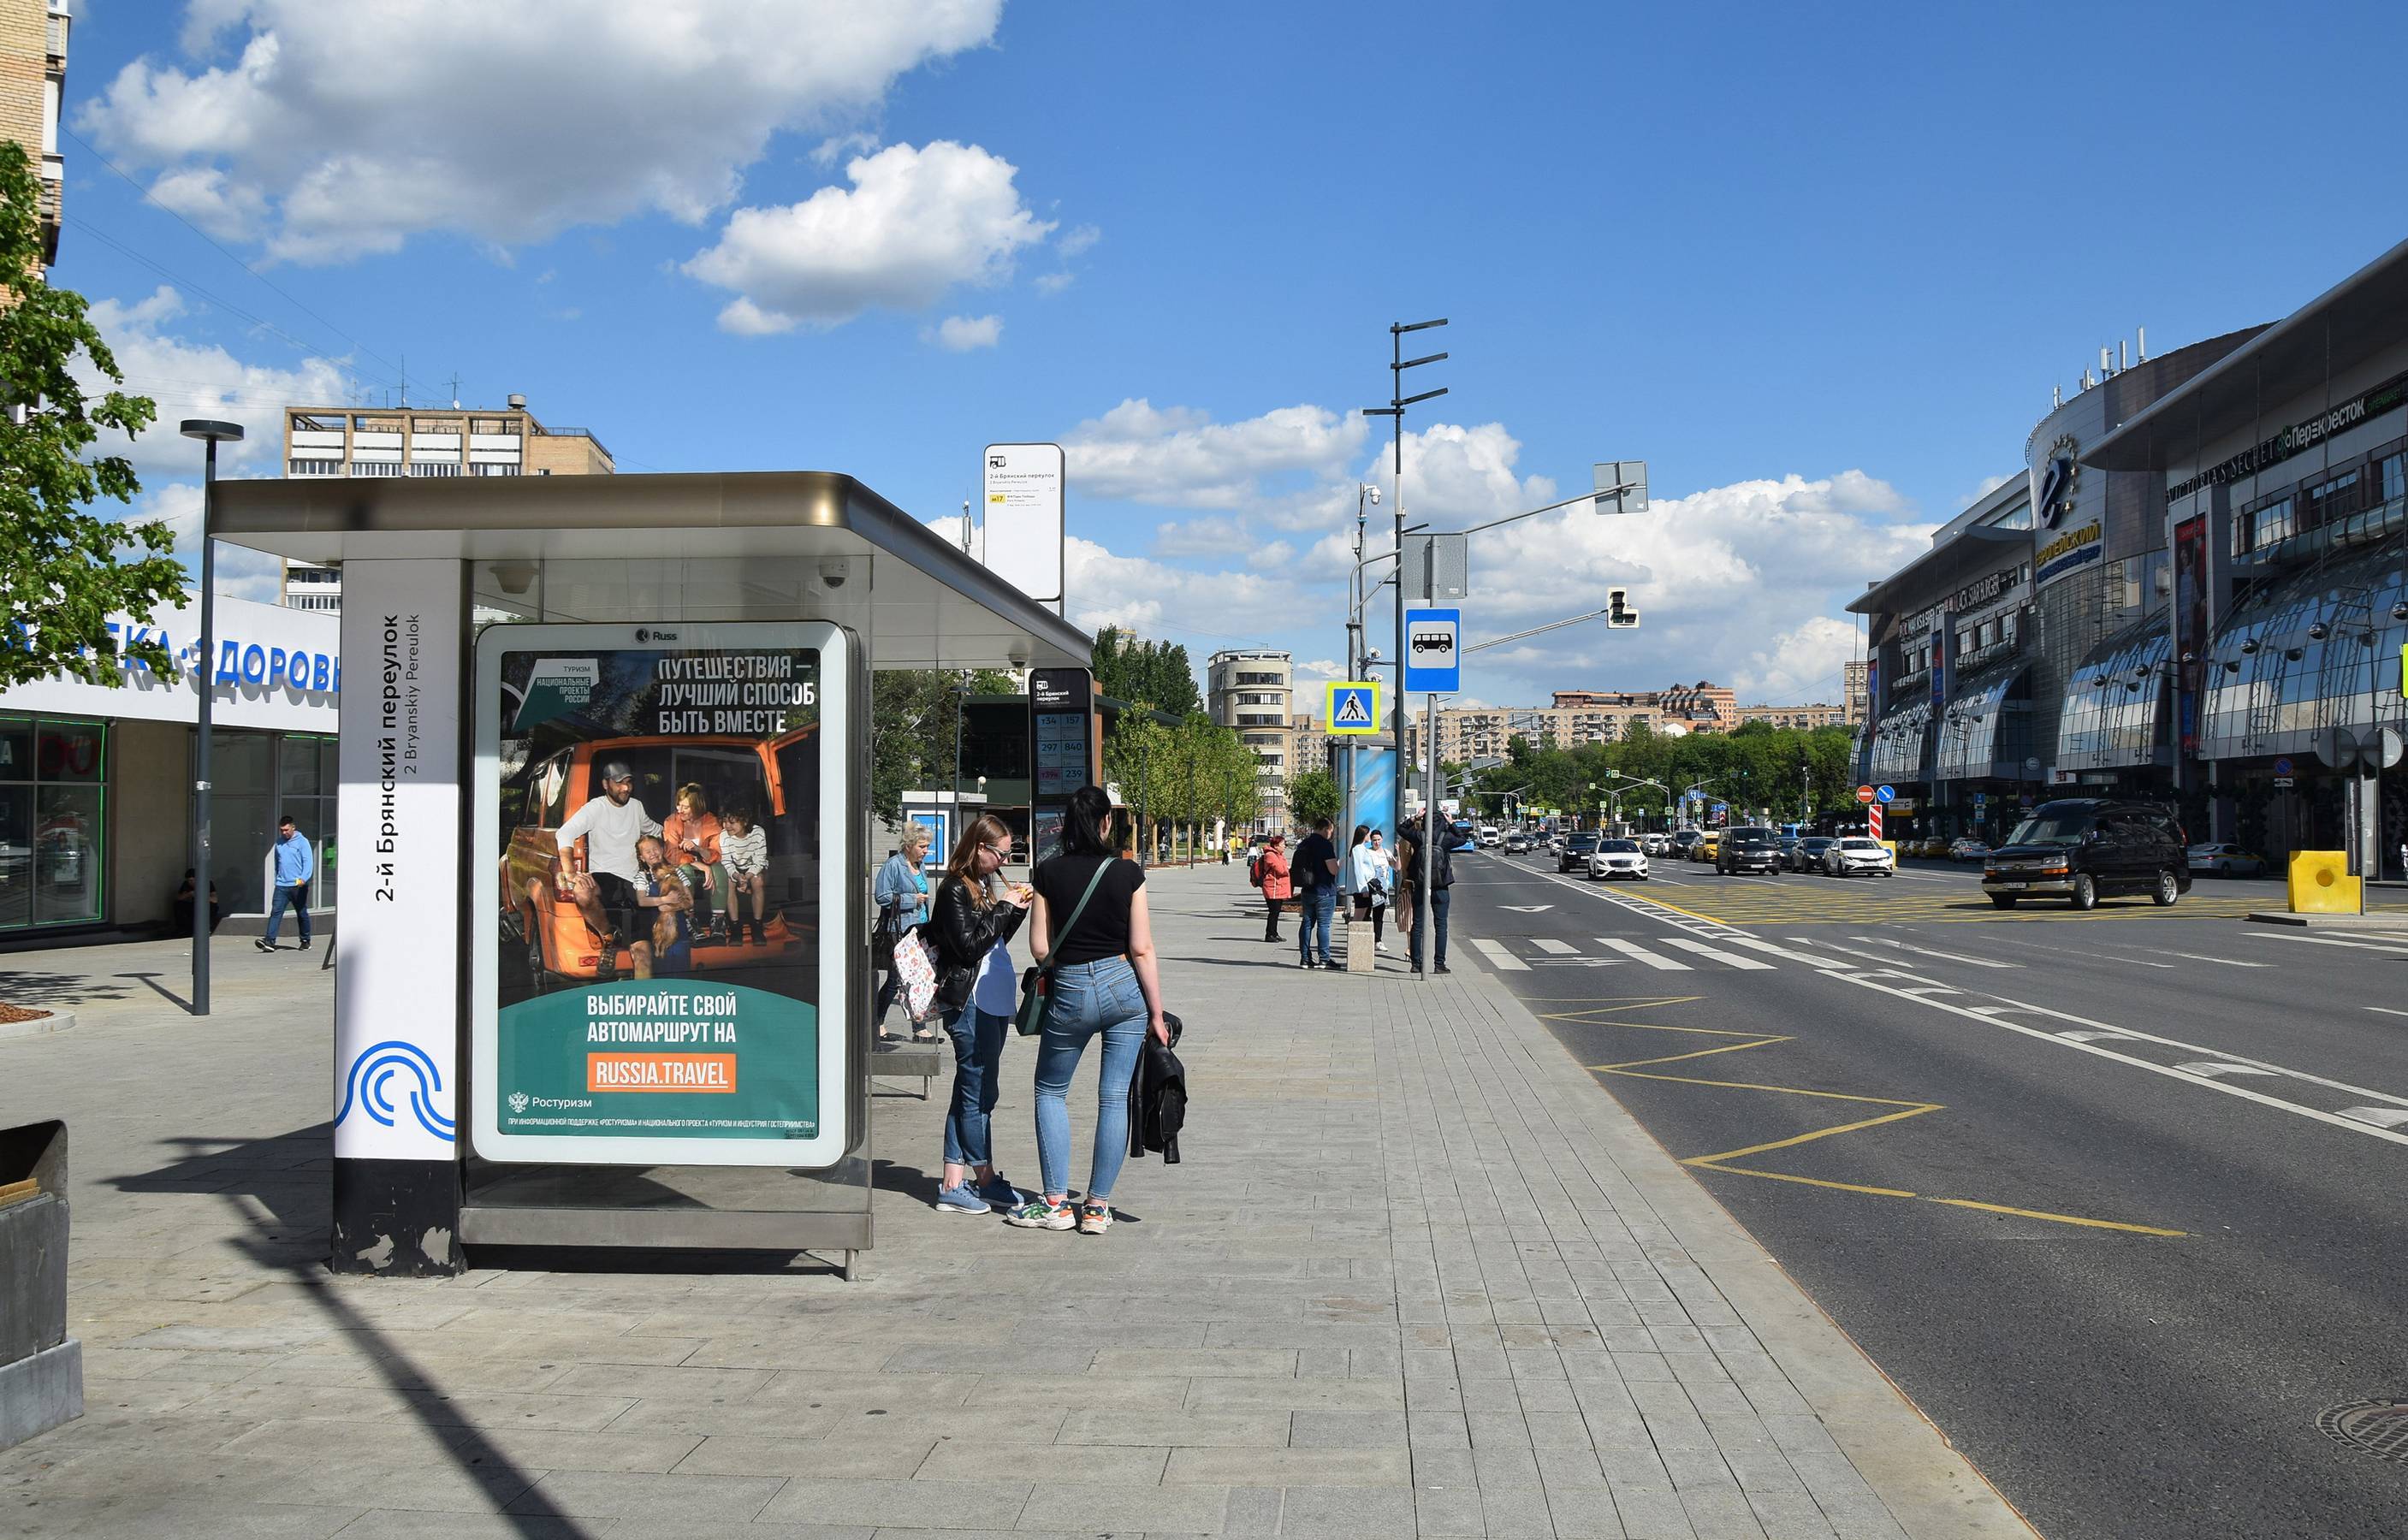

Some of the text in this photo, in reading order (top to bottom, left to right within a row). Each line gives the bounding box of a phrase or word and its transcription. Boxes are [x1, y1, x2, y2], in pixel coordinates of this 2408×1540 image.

[653, 631, 678, 641] Russ
[658, 655, 792, 680] ПУТЕШЕСТВИЯ
[537, 678, 590, 687] НАЦИОНАЛЬНЫЕ
[404, 613, 421, 774] 2 Bryanskiy Pereulok
[559, 686, 590, 696] ПРОЕКТЫ
[658, 679, 816, 707] ЛУЧШИЙ СПОСОБ
[565, 695, 590, 703] РОССИИ
[658, 710, 787, 734] БЫТЬ ВМЕСТЕ
[1066, 716, 1080, 725] 157
[1041, 743, 1058, 752] 297
[1065, 743, 1082, 751] 840
[376, 614, 402, 902] 2-й Брянский переулок
[587, 991, 736, 1016] ВЫБИРАЙТЕ СВОЙ
[587, 1022, 736, 1043] АВТОМАРШРУТ НА
[596, 1062, 728, 1085] RUSSIA.TRAVEL
[532, 1097, 592, 1110] Ростуризм
[519, 1117, 566, 1126] ИНФОРМАЦИОННОЙ
[567, 1118, 599, 1127] ПОДДЕРЖКЕ
